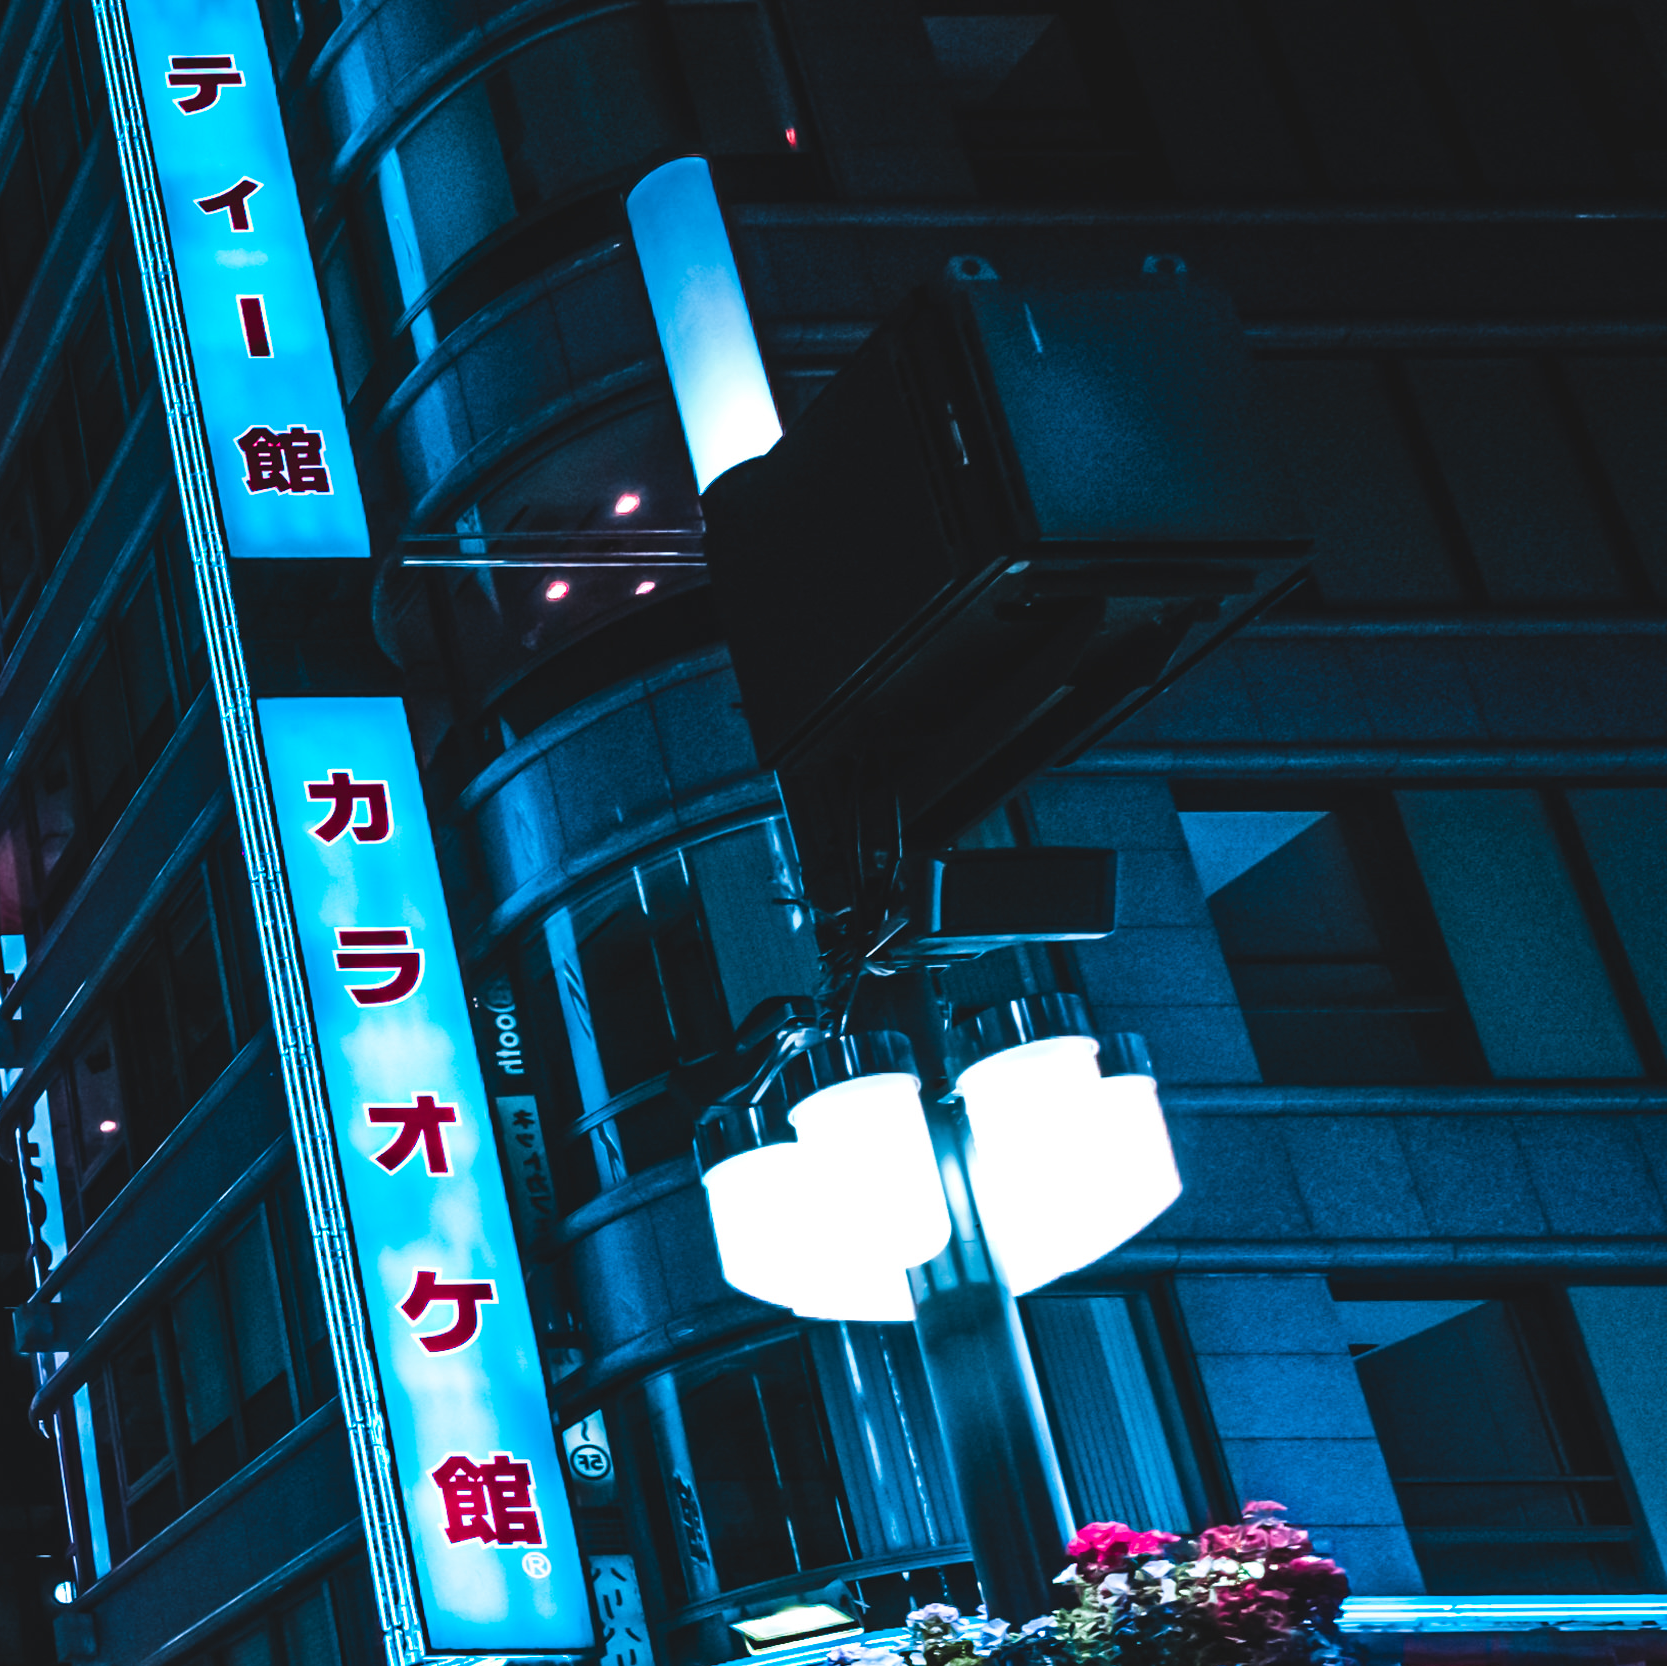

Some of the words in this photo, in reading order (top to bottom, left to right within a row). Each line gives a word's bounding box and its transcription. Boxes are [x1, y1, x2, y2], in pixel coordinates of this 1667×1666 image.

[165, 54, 335, 496] ティー館
[303, 767, 548, 1548] カラオケ館
